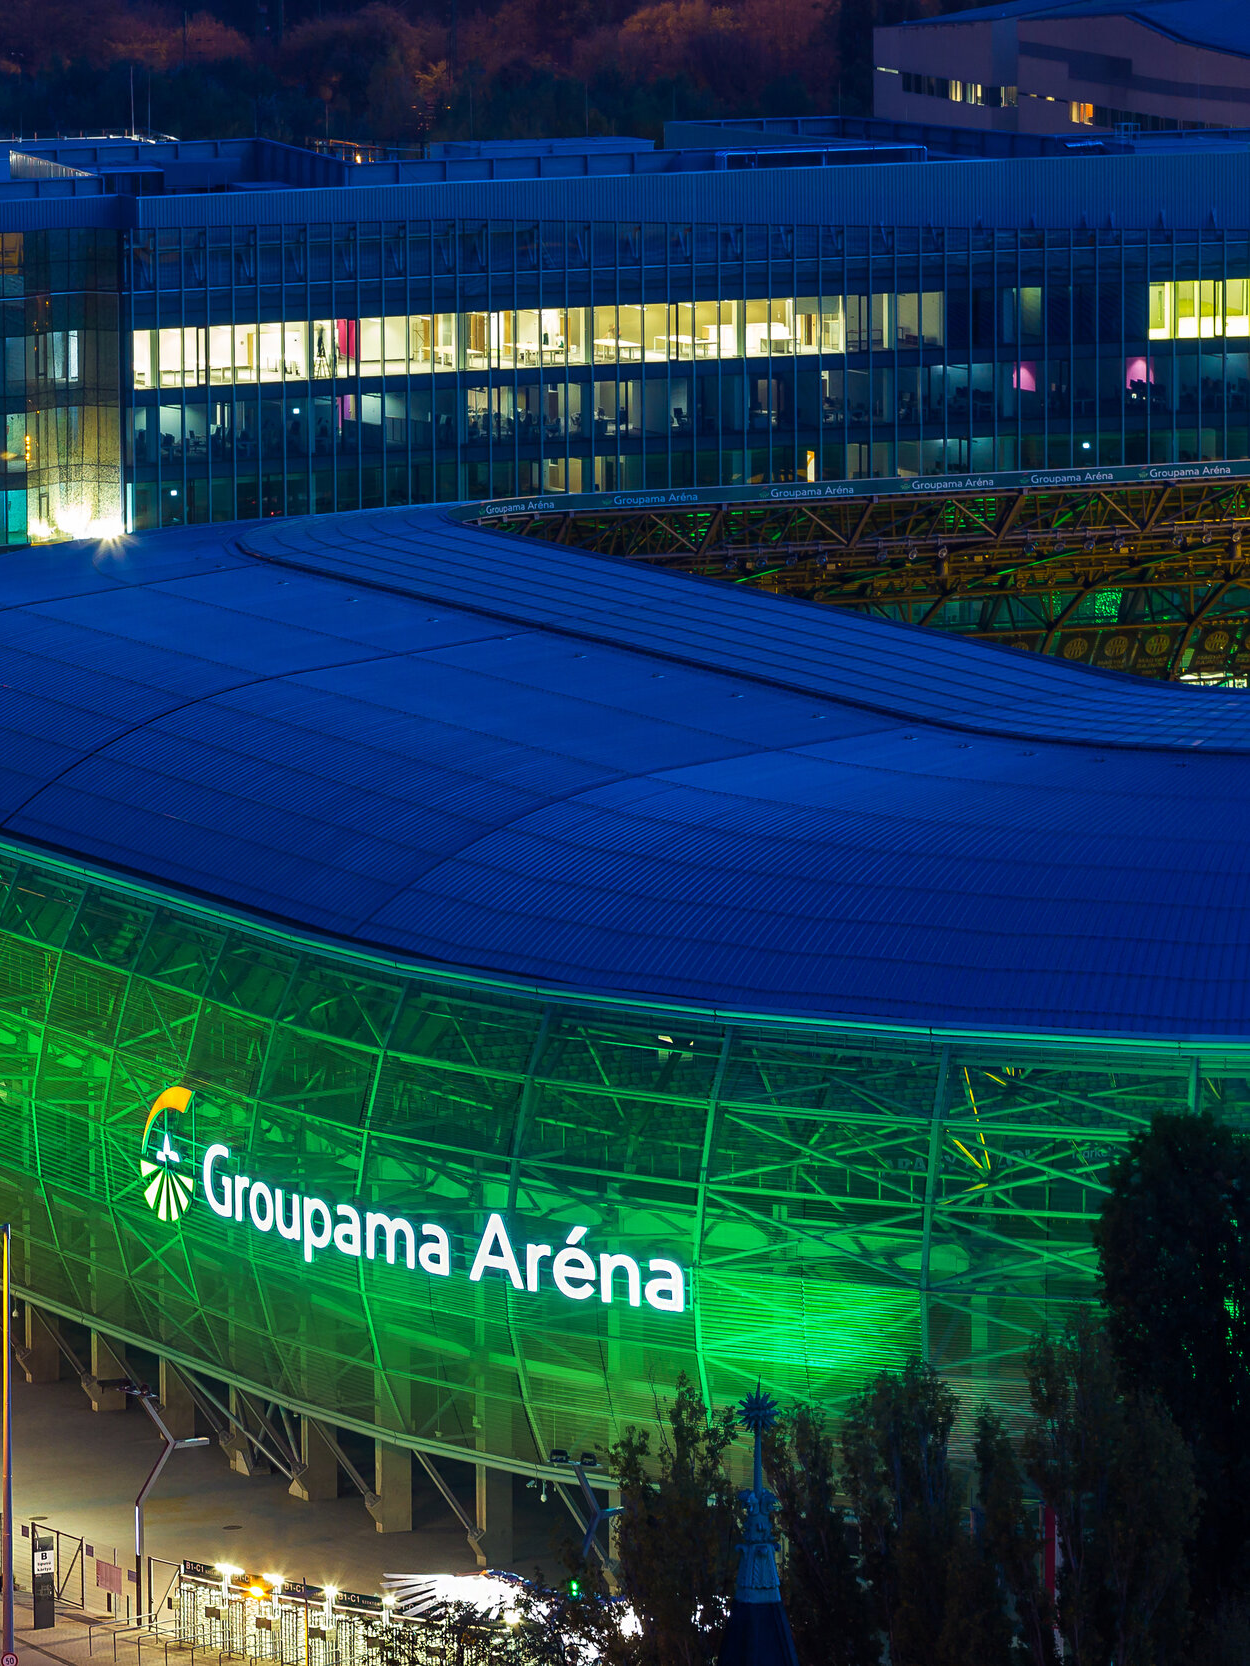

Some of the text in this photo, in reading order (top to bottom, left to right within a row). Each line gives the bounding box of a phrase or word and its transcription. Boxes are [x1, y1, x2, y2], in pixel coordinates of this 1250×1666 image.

[1030, 471, 1114, 485] Groupama Aréna
[1149, 465, 1231, 479] Groupama Aréna
[911, 477, 994, 491] Groupama Aréna
[613, 491, 699, 505] Groupama Aréna
[770, 484, 854, 499] Groupama Aréna
[485, 500, 555, 514] Groupama Aréna
[202, 1143, 687, 1313] Groupama Aréna
[40, 1552, 48, 1560] B
[185, 1561, 204, 1573] B1-C1
[284, 1583, 305, 1593] B1-C1
[338, 1592, 360, 1603] B1-C1
[5, 1657, 15, 1666] 50
